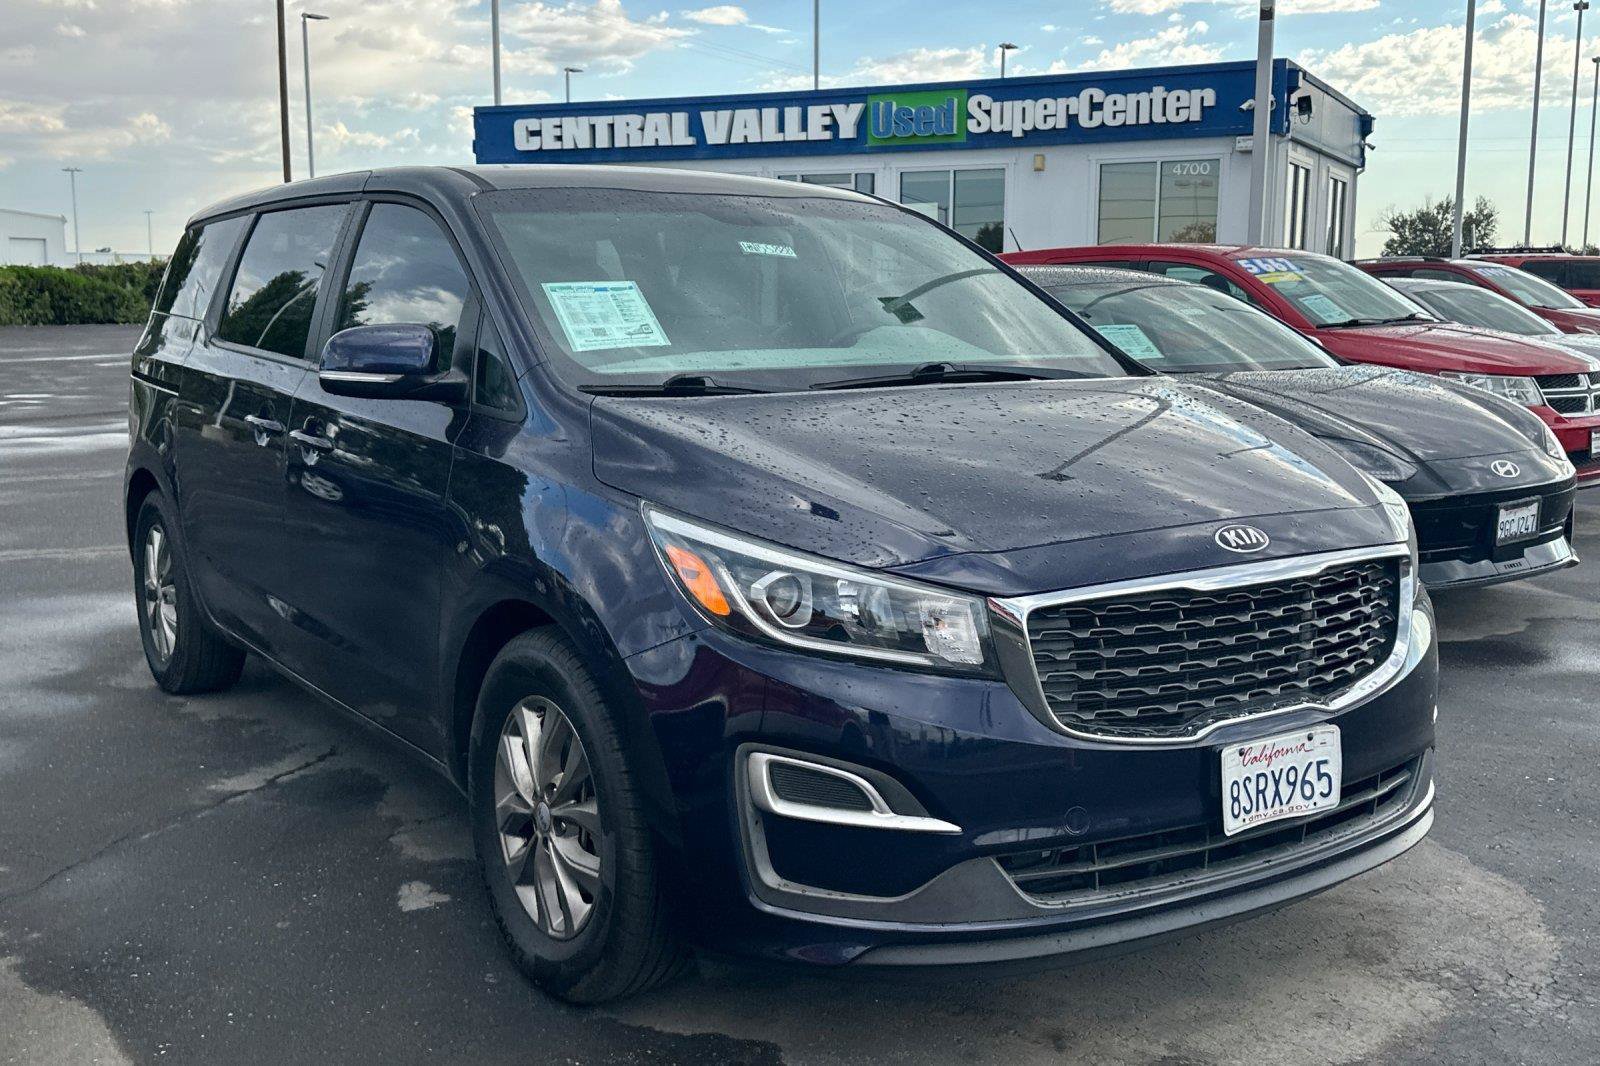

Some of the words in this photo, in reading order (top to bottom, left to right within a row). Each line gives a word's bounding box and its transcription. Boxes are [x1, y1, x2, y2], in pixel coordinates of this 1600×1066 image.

[513, 111, 696, 151] CENTRAL
[700, 103, 866, 145] VALLEY
[871, 97, 958, 138] Used
[966, 85, 1217, 138] SuperCenter
[1172, 161, 1210, 176] 4700
[1221, 527, 1267, 547] KIA
[1499, 513, 1536, 538] 9GCJ247
[1242, 742, 1314, 768] California
[1230, 759, 1333, 819] 8SRX965
[1247, 803, 1311, 823] dmv.ca.gov
